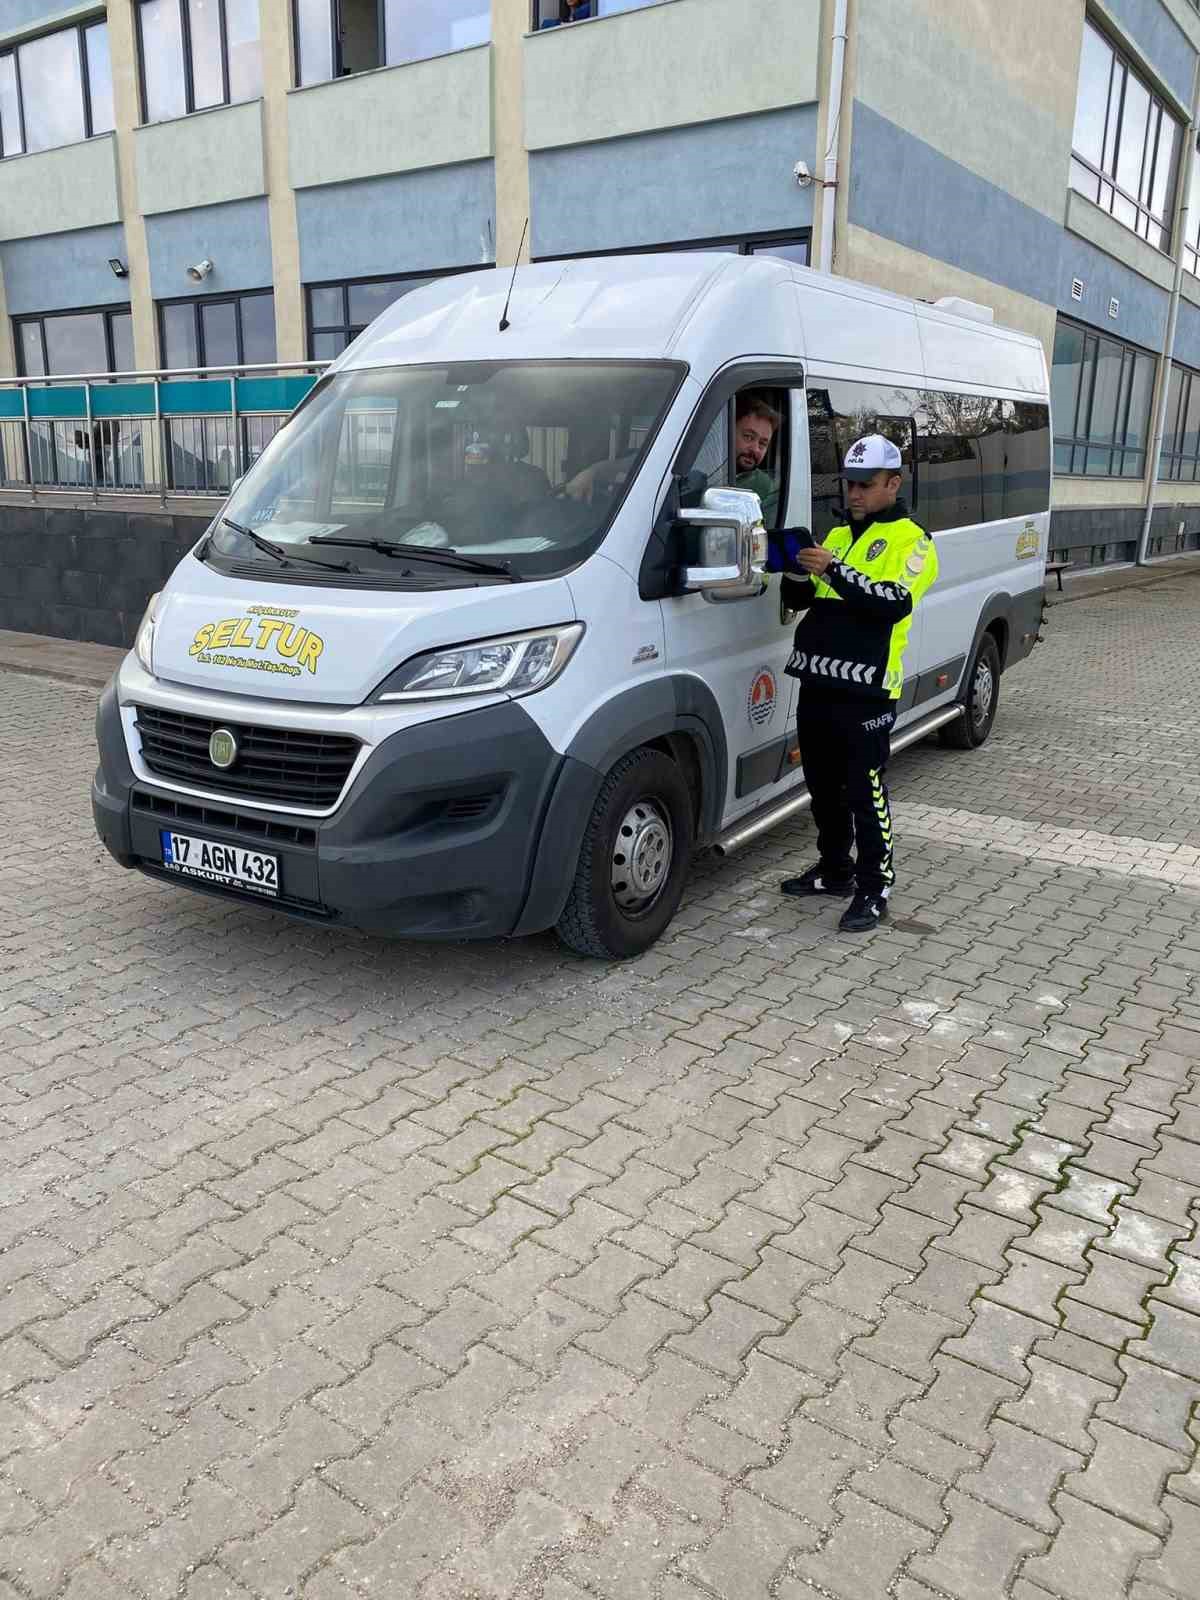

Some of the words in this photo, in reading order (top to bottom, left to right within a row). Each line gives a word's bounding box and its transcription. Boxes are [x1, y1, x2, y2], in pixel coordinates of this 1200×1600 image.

[189, 617, 324, 674] SELTUR
[173, 836, 190, 863] 17
[201, 843, 237, 875] AGN
[242, 853, 276, 885] 432
[181, 864, 231, 885] ASKURT
